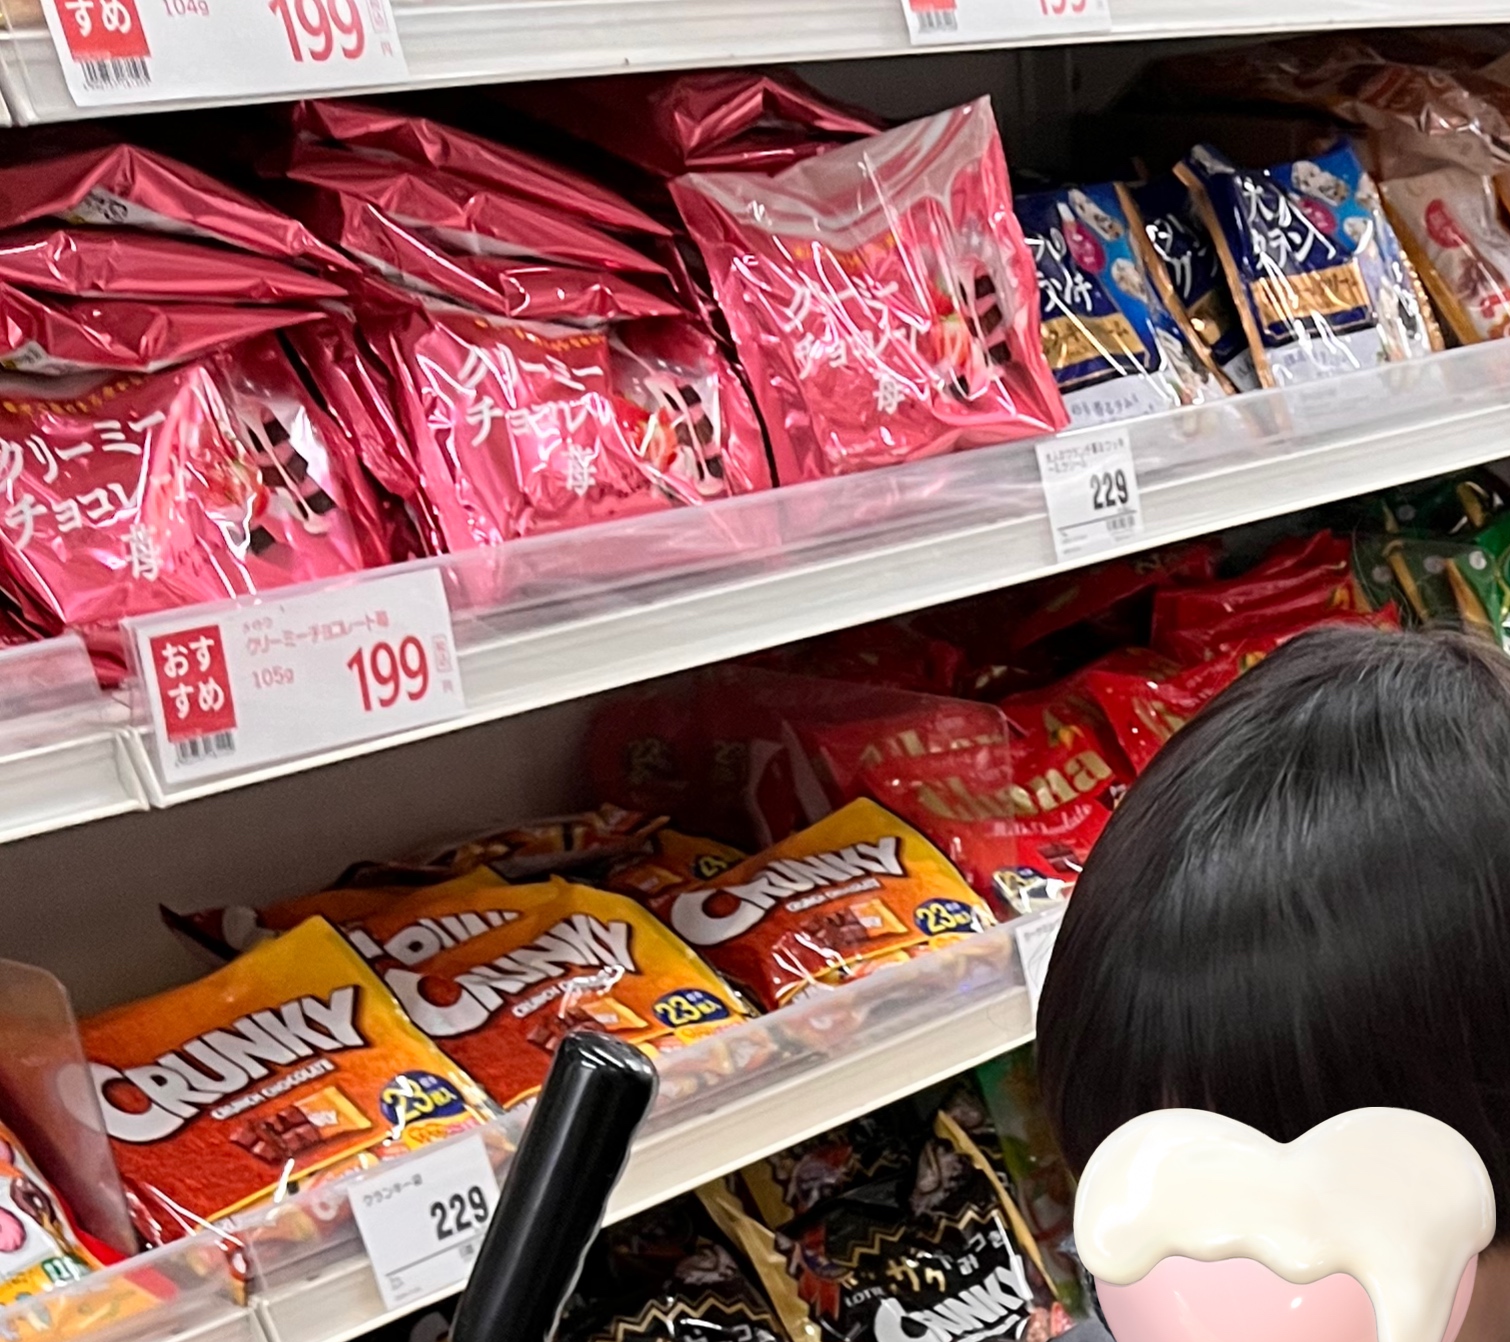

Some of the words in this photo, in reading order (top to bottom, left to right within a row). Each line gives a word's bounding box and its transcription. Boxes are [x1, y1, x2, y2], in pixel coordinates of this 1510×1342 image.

[269, 0, 365, 61] 199
[1090, 468, 1130, 511] 229
[251, 666, 295, 690] 105g
[347, 634, 431, 713] 199
[670, 835, 904, 946] CRUNKY
[384, 913, 636, 1037] CRUNKY
[56, 985, 365, 1143] CRUNKY
[430, 1185, 489, 1242] 229
